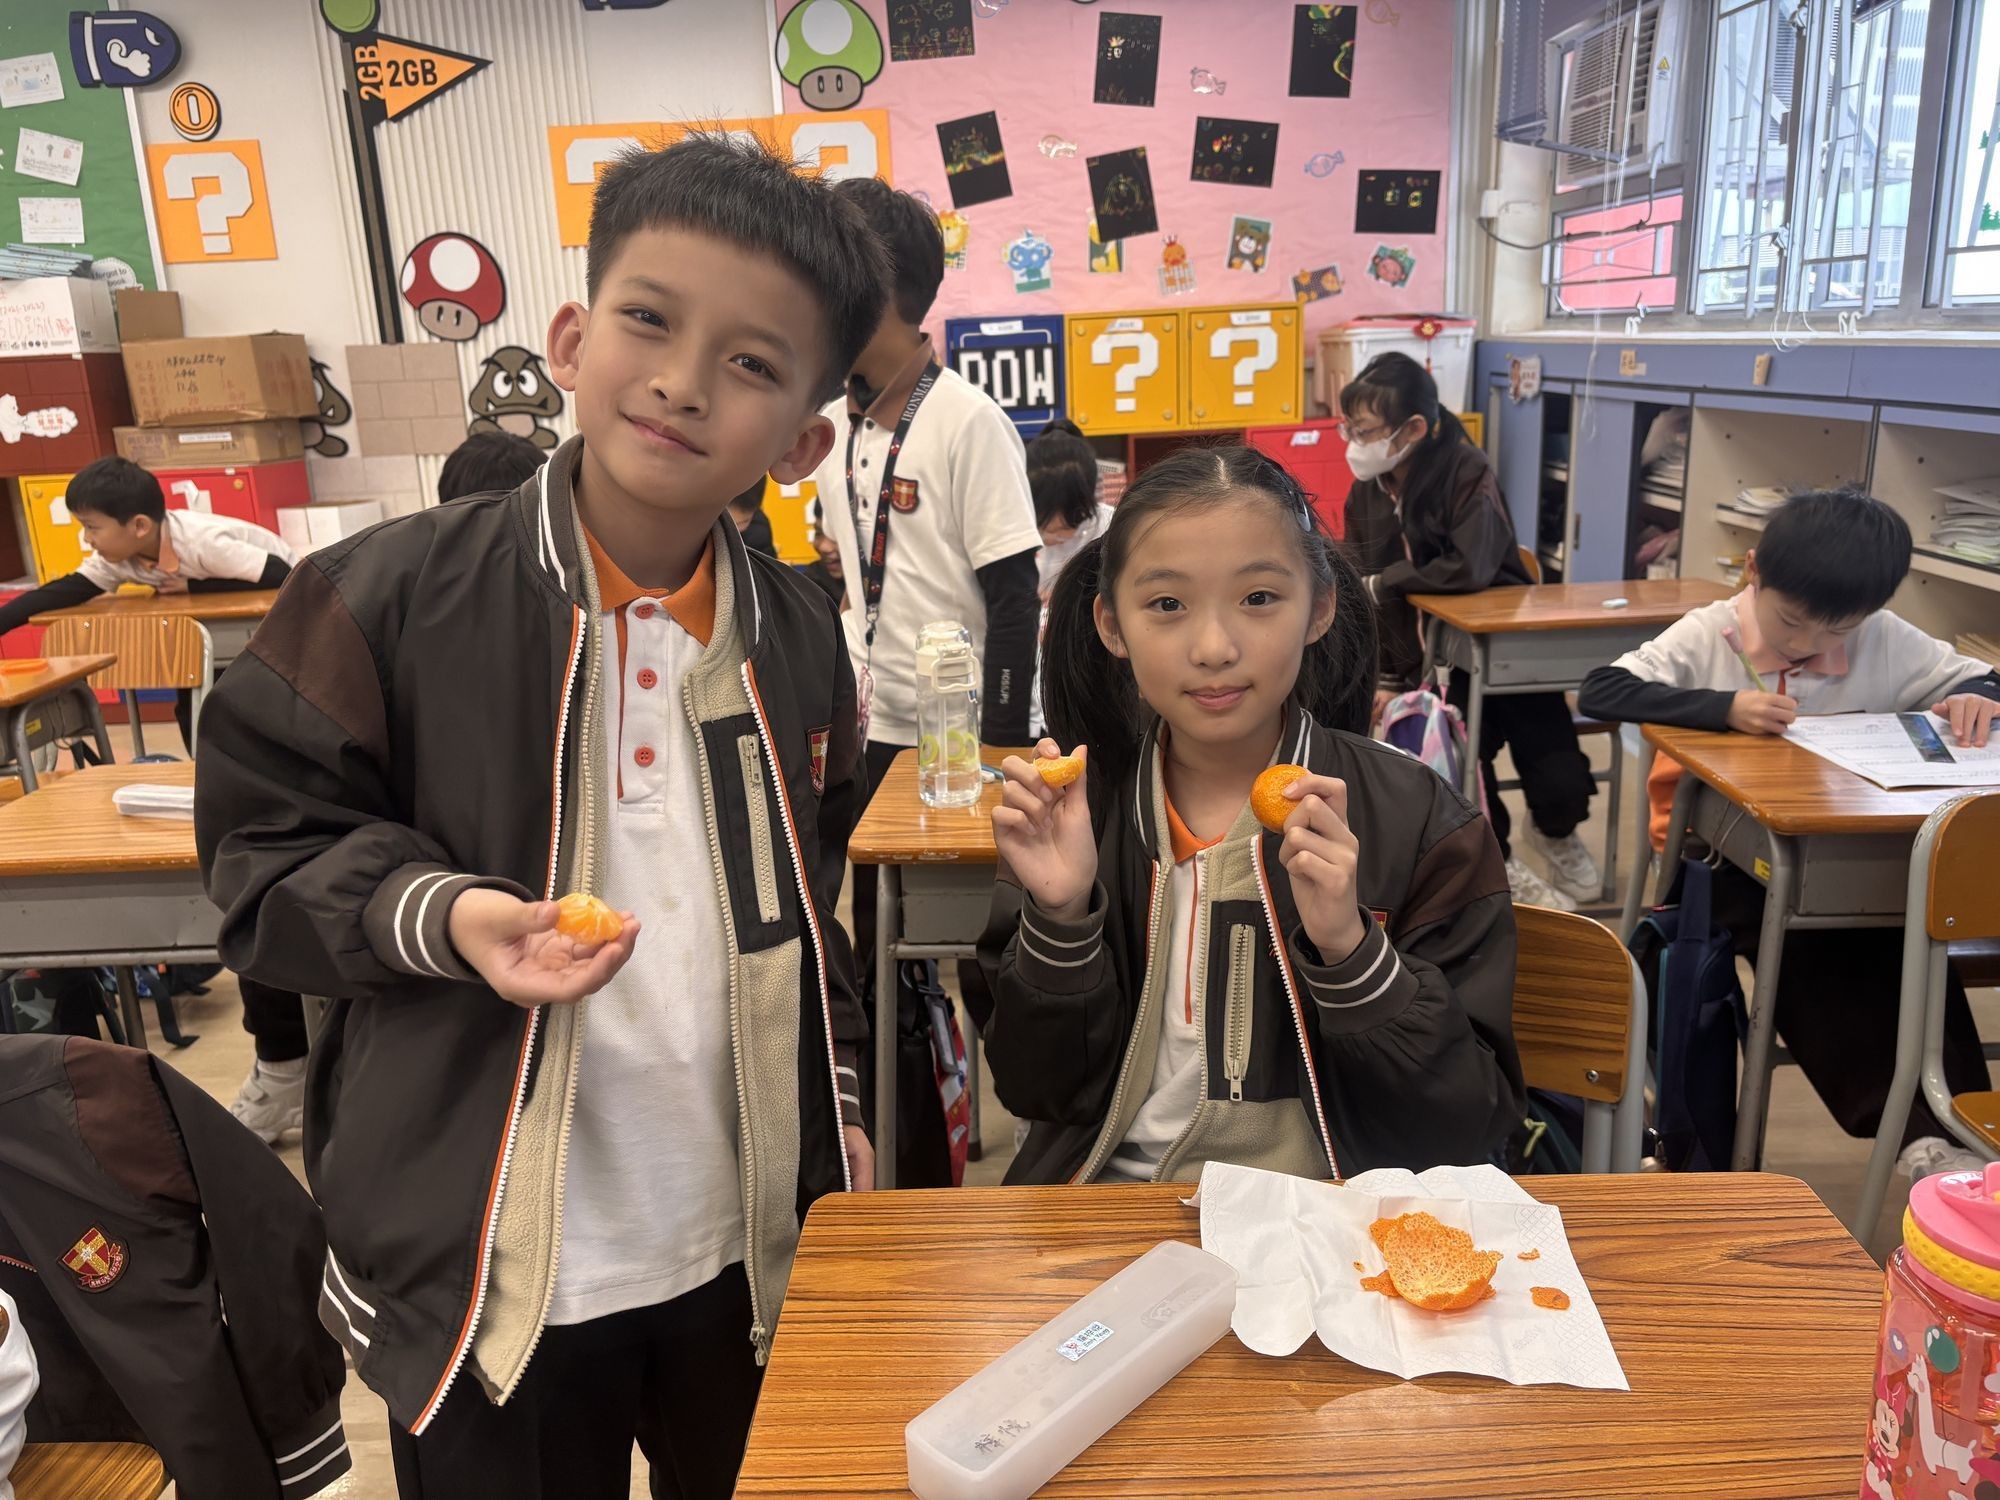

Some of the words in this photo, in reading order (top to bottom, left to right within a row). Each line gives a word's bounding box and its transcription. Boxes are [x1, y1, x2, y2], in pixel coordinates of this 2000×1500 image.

[355, 45, 386, 101] 2GB
[386, 58, 438, 88] 2GB
[900, 374, 934, 422] IRONMAN
